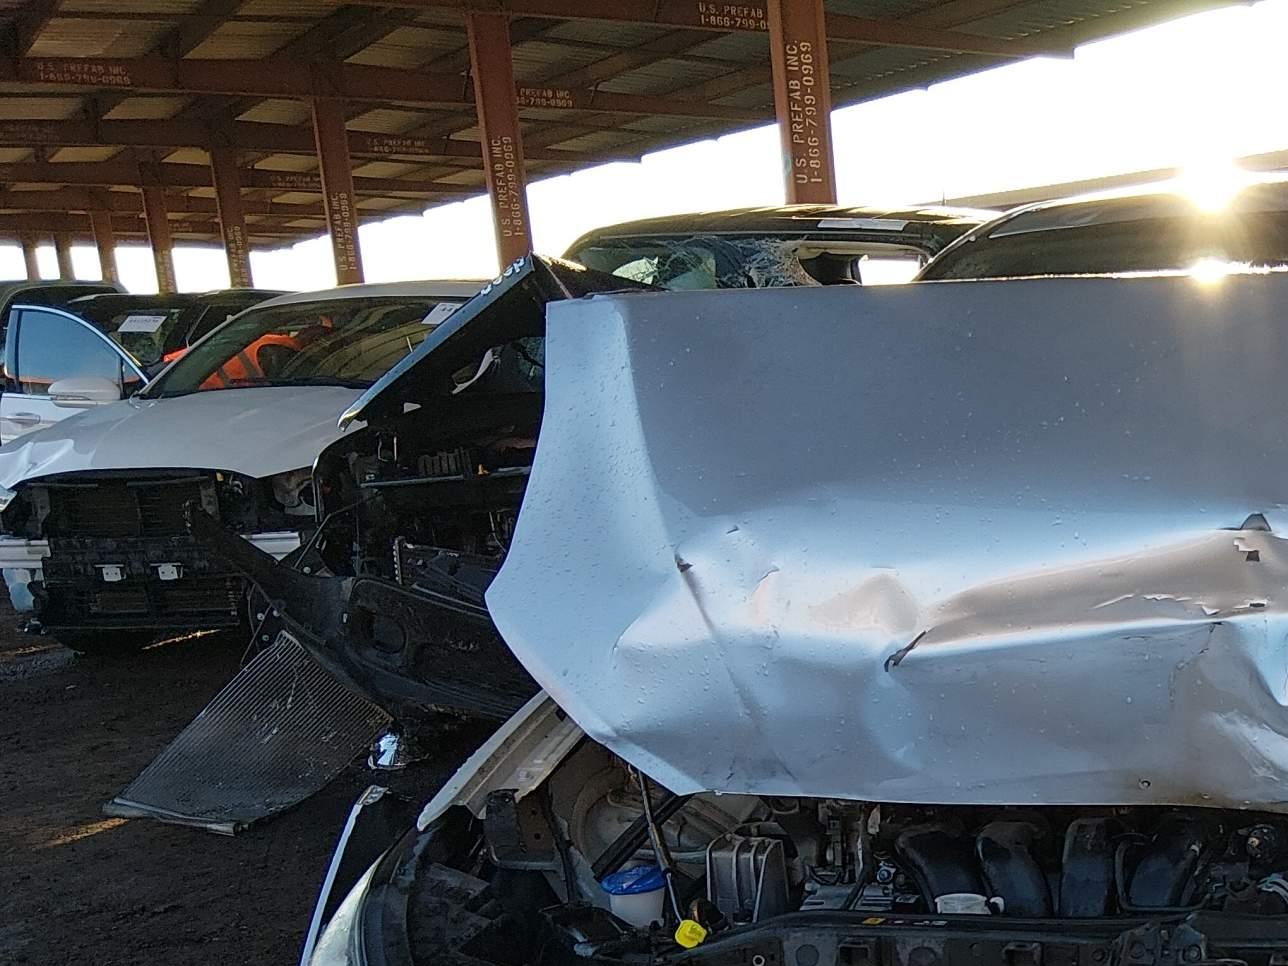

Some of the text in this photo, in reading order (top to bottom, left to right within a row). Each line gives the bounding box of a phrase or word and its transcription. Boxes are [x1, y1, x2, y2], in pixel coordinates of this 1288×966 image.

[723, 5, 764, 19] PREFAB
[786, 39, 809, 184] U.S. PREFAB INC.
[799, 41, 823, 184] 1-866-799-0969
